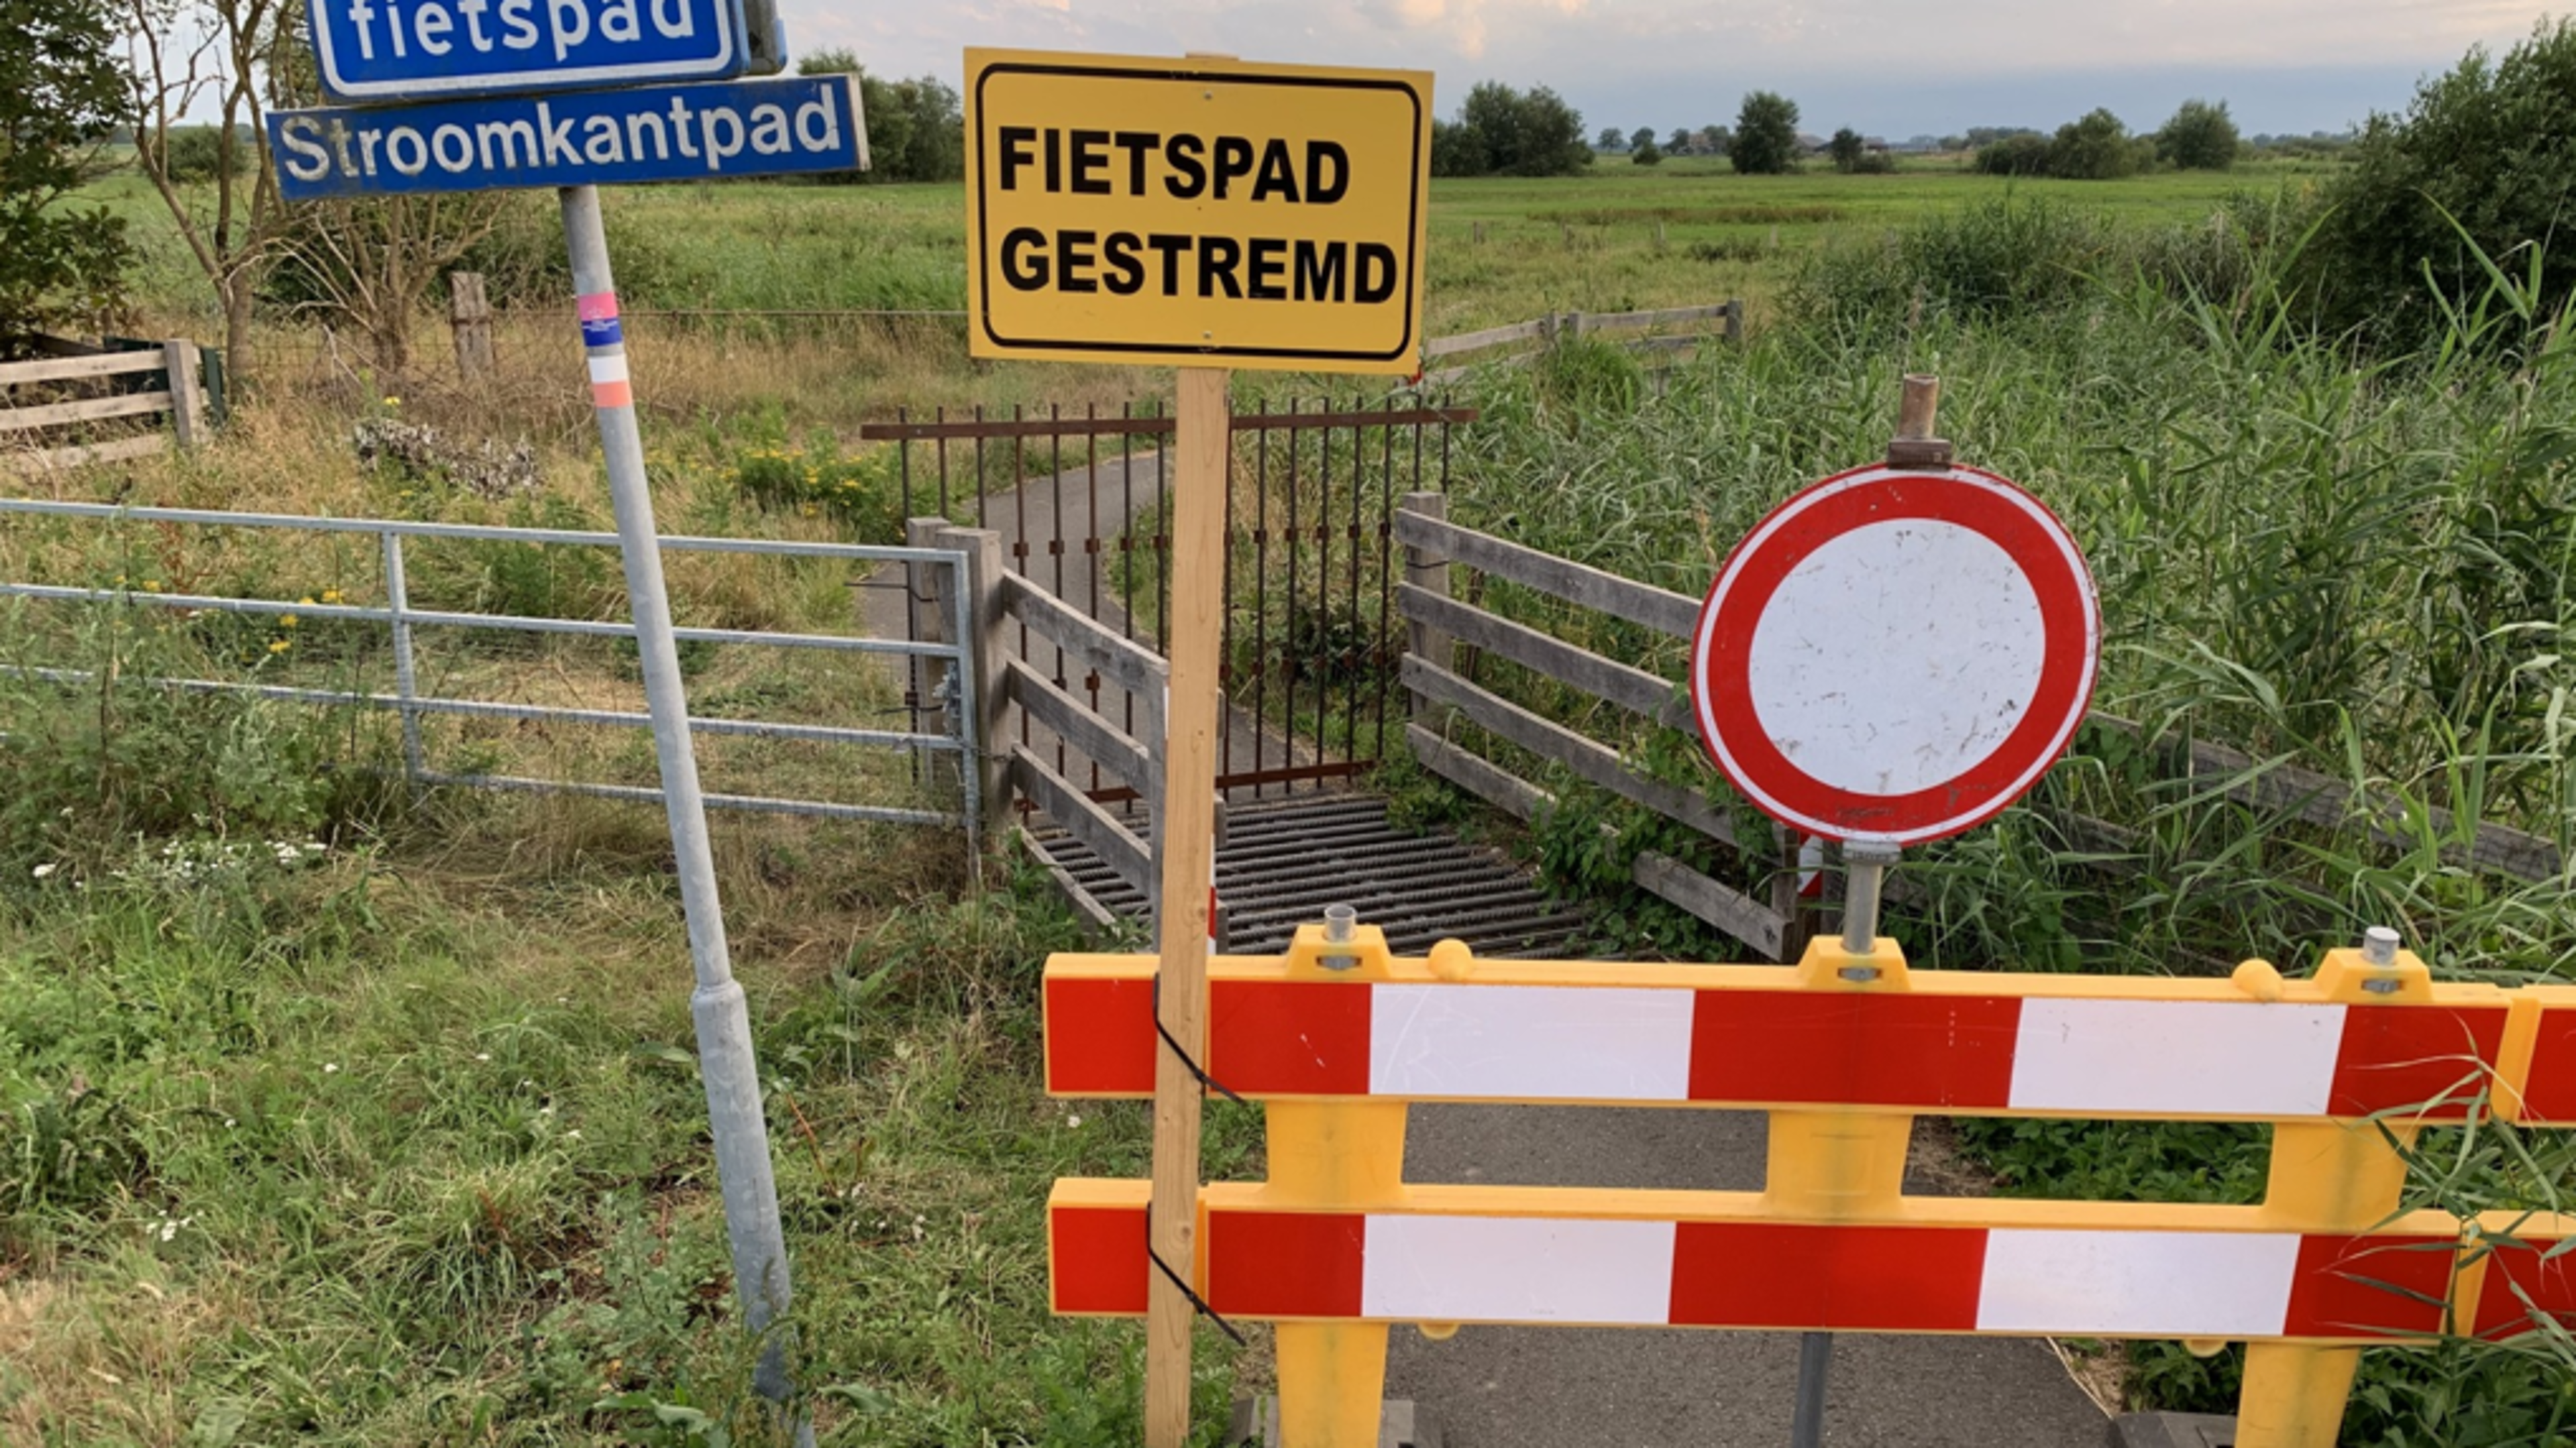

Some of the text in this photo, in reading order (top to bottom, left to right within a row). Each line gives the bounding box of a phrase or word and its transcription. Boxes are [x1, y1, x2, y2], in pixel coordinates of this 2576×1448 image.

[349, 0, 694, 61] fietspad
[281, 84, 841, 182] Stroomkantpad
[999, 126, 1349, 204] FIETSPAD
[1000, 227, 1397, 304] GESTREMD
